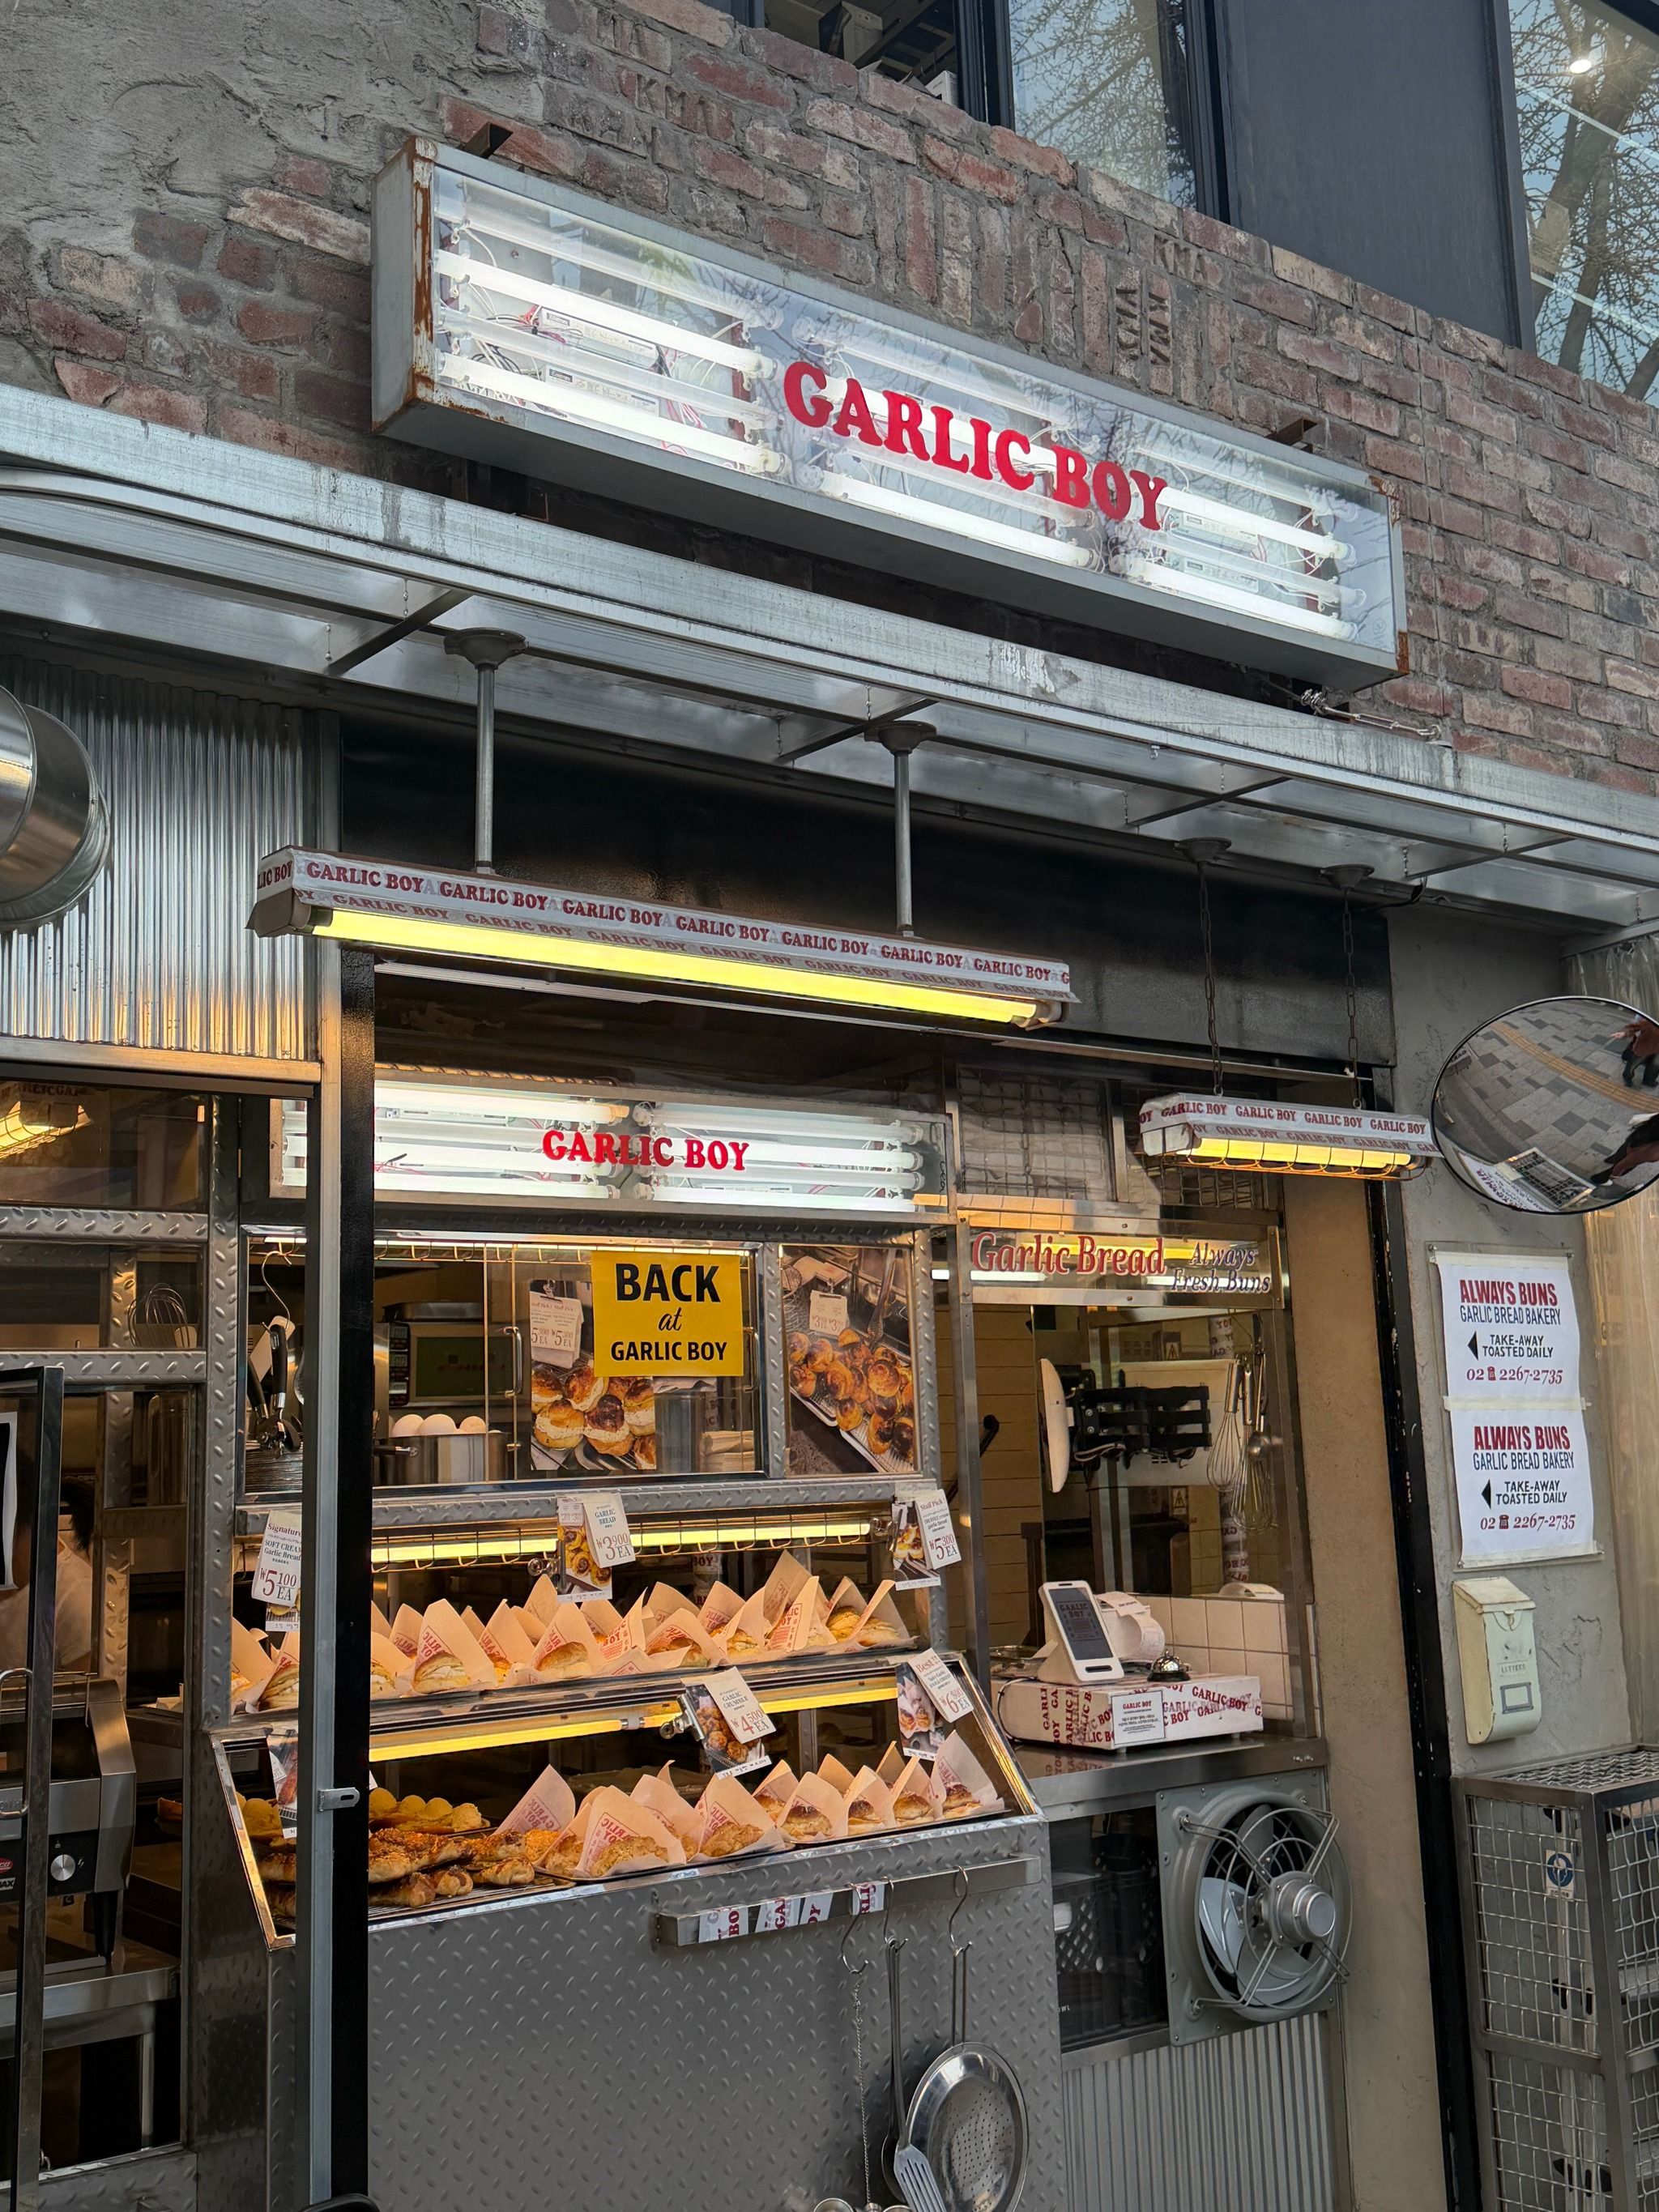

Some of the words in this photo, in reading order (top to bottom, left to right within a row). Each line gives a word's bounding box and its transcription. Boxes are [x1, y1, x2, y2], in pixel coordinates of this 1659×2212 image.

[784, 360, 1034, 491] GARLIC
[1052, 445, 1167, 531] BOY
[274, 861, 292, 883] BOY
[306, 862, 381, 887] GARLIC
[386, 873, 424, 893] BOY
[439, 881, 509, 906] GARLIC
[512, 891, 548, 911] BOY
[563, 899, 626, 922] GARLIC
[629, 908, 663, 927] BOY
[676, 915, 735, 938] GARLIC
[740, 925, 770, 943] BOY
[782, 931, 838, 953] GARLIC
[841, 940, 870, 956] BOY
[881, 944, 932, 965] GARLIC
[936, 952, 963, 969] BOY
[974, 958, 1022, 977] GARLIC
[1026, 965, 1051, 981] BOY
[333, 894, 406, 914] GARLIC
[410, 906, 450, 921] BOY
[465, 913, 535, 933] GARLIC
[537, 923, 573, 937] BOY
[586, 929, 651, 947] GARLIC
[654, 939, 689, 953] BOY
[700, 945, 761, 963] GARLIC
[764, 953, 793, 967] BOY
[804, 960, 860, 976] GARLIC
[863, 966, 892, 978] BOY
[902, 971, 955, 987] GARLIC
[957, 978, 985, 989] BOY
[993, 982, 1043, 997] GARLIC
[1045, 988, 1072, 999] BOY
[1161, 1102, 1204, 1117] GARLIC
[1206, 1103, 1226, 1115] BOY
[1235, 1106, 1274, 1119] GARLIC
[1277, 1109, 1296, 1122] BOY
[1304, 1112, 1341, 1126] GARLIC
[1343, 1115, 1363, 1128] BOY
[1370, 1119, 1405, 1132] GARLIC
[1407, 1122, 1426, 1134] BOY
[1216, 1126, 1257, 1137] GARLIC
[1259, 1129, 1278, 1139] BOY
[1286, 1132, 1326, 1144] GARLIC
[1328, 1136, 1346, 1145] BOY
[1354, 1137, 1391, 1149] GARLIC
[1392, 1141, 1411, 1150] BOY
[542, 1130, 674, 1166] GARLIC
[684, 1138, 749, 1171] BOY
[972, 1231, 1070, 1274] Garlic
[1076, 1235, 1166, 1275] Bread
[1189, 1242, 1257, 1268] Always
[616, 1264, 721, 1302] BACK
[1171, 1268, 1220, 1291] Fresh
[1225, 1269, 1271, 1294] Buns
[1459, 1279, 1516, 1306] ALWAYS
[1518, 1282, 1558, 1306] BUNS
[659, 1307, 682, 1331] at
[1460, 1305, 1492, 1323] GARLIC
[1495, 1307, 1524, 1324] BREAD
[1525, 1307, 1561, 1325] BAKERY
[1490, 1334, 1544, 1347] TAKE-AWAY
[611, 1341, 682, 1361] GARLIC
[688, 1341, 727, 1361] BOY
[1482, 1346, 1525, 1357] TOASTED
[1527, 1346, 1554, 1358] DAILY
[1466, 1369, 1484, 1381] 02
[1473, 1426, 1532, 1450] ALWAYS
[1535, 1426, 1571, 1451] BUNS
[1473, 1452, 1508, 1470] GARLIC
[1511, 1452, 1540, 1469] BREAD
[1542, 1451, 1574, 1469] BAKERY
[1504, 1480, 1560, 1493] TAKE-AWAY
[1496, 1494, 1540, 1505] TOASTED
[1542, 1491, 1567, 1503] DAILY
[595, 1509, 616, 1518] GARLIC
[599, 1516, 616, 1525] BREAD
[1480, 1517, 1495, 1530] 02
[1513, 1514, 1576, 1530] 2267-2735
[264, 1547, 282, 1558] Garlic
[265, 1540, 279, 1549] SOFT
[618, 1546, 631, 1558] EA
[946, 1545, 957, 1557] EA
[277, 1588, 292, 1601] EA
[915, 1660, 934, 1673] Best
[722, 1691, 742, 1702] GARLIC
[1192, 1686, 1227, 1706] GARLIC
[1228, 1698, 1248, 1712] BOY
[1123, 1702, 1141, 1710] GARLIC
[1171, 1710, 1190, 1724] BOY
[753, 1719, 770, 1733] EA
